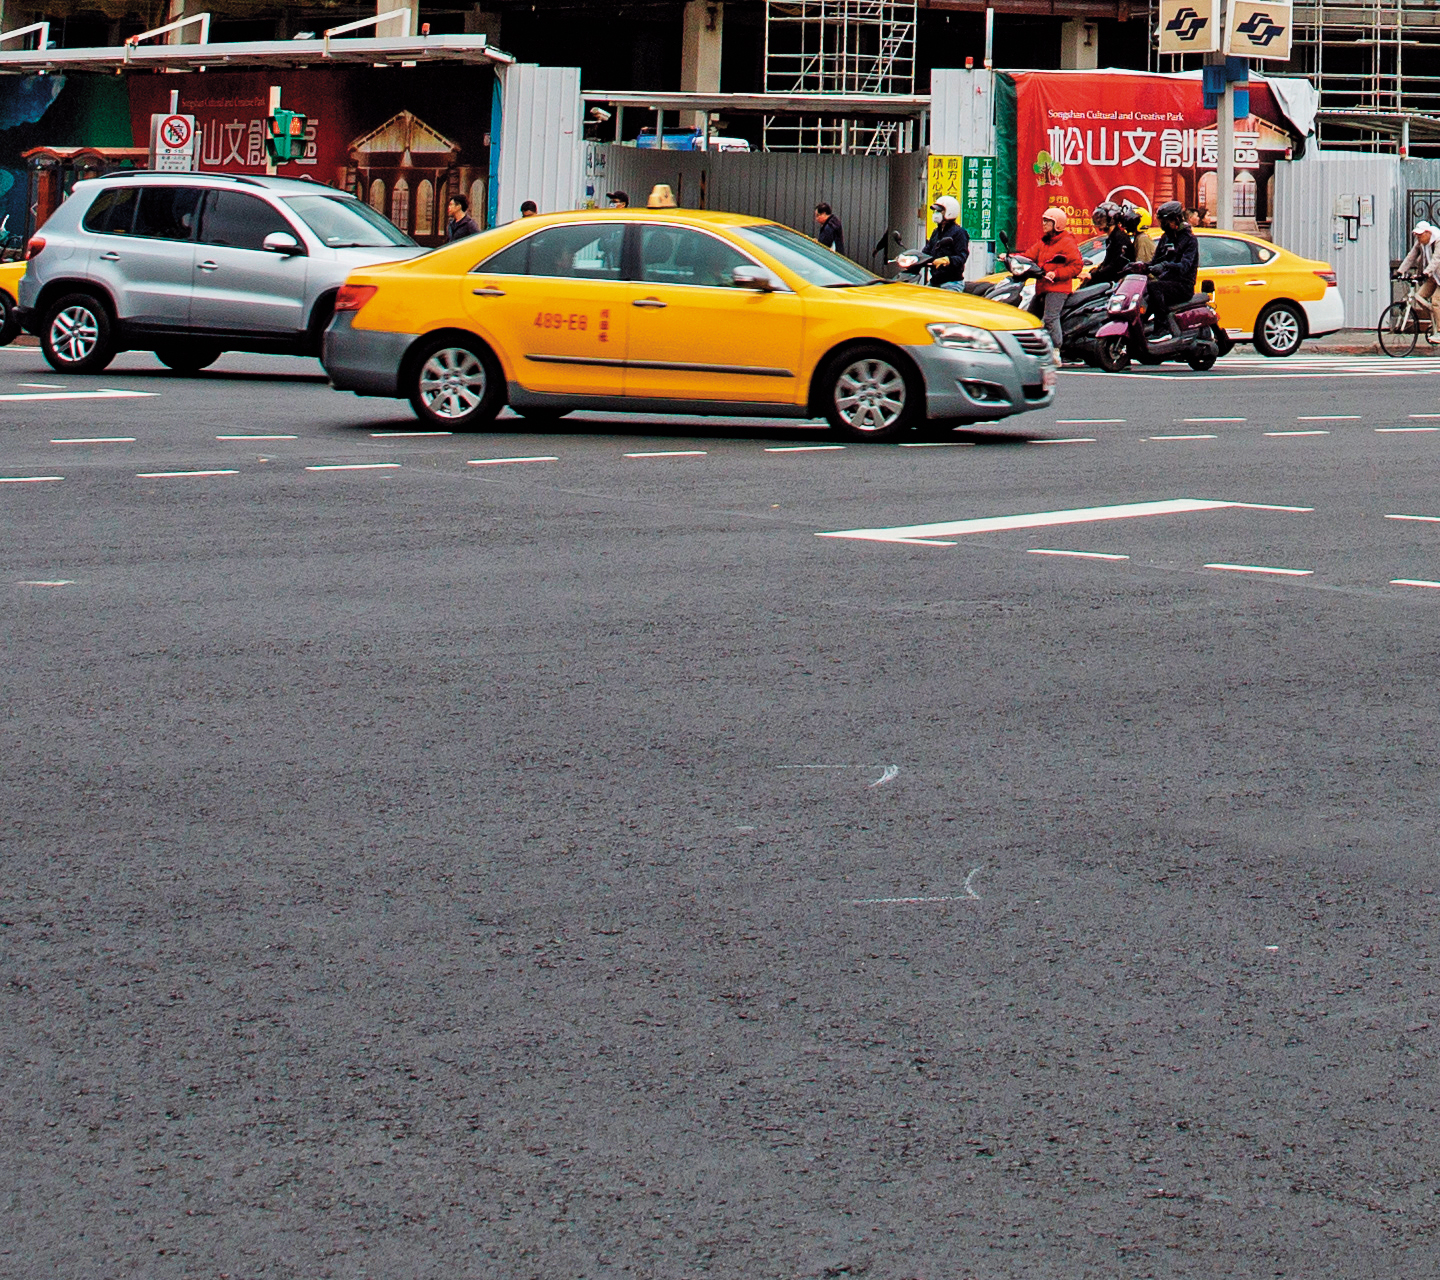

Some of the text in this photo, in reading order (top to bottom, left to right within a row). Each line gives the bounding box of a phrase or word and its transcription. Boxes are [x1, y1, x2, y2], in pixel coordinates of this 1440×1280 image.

[1048, 110, 1184, 120] Songshan Cultural and Creative Park
[196, 118, 319, 165] 山文創區
[1047, 126, 1259, 168] 松山文創園區
[1049, 206, 1090, 217] 00公尺
